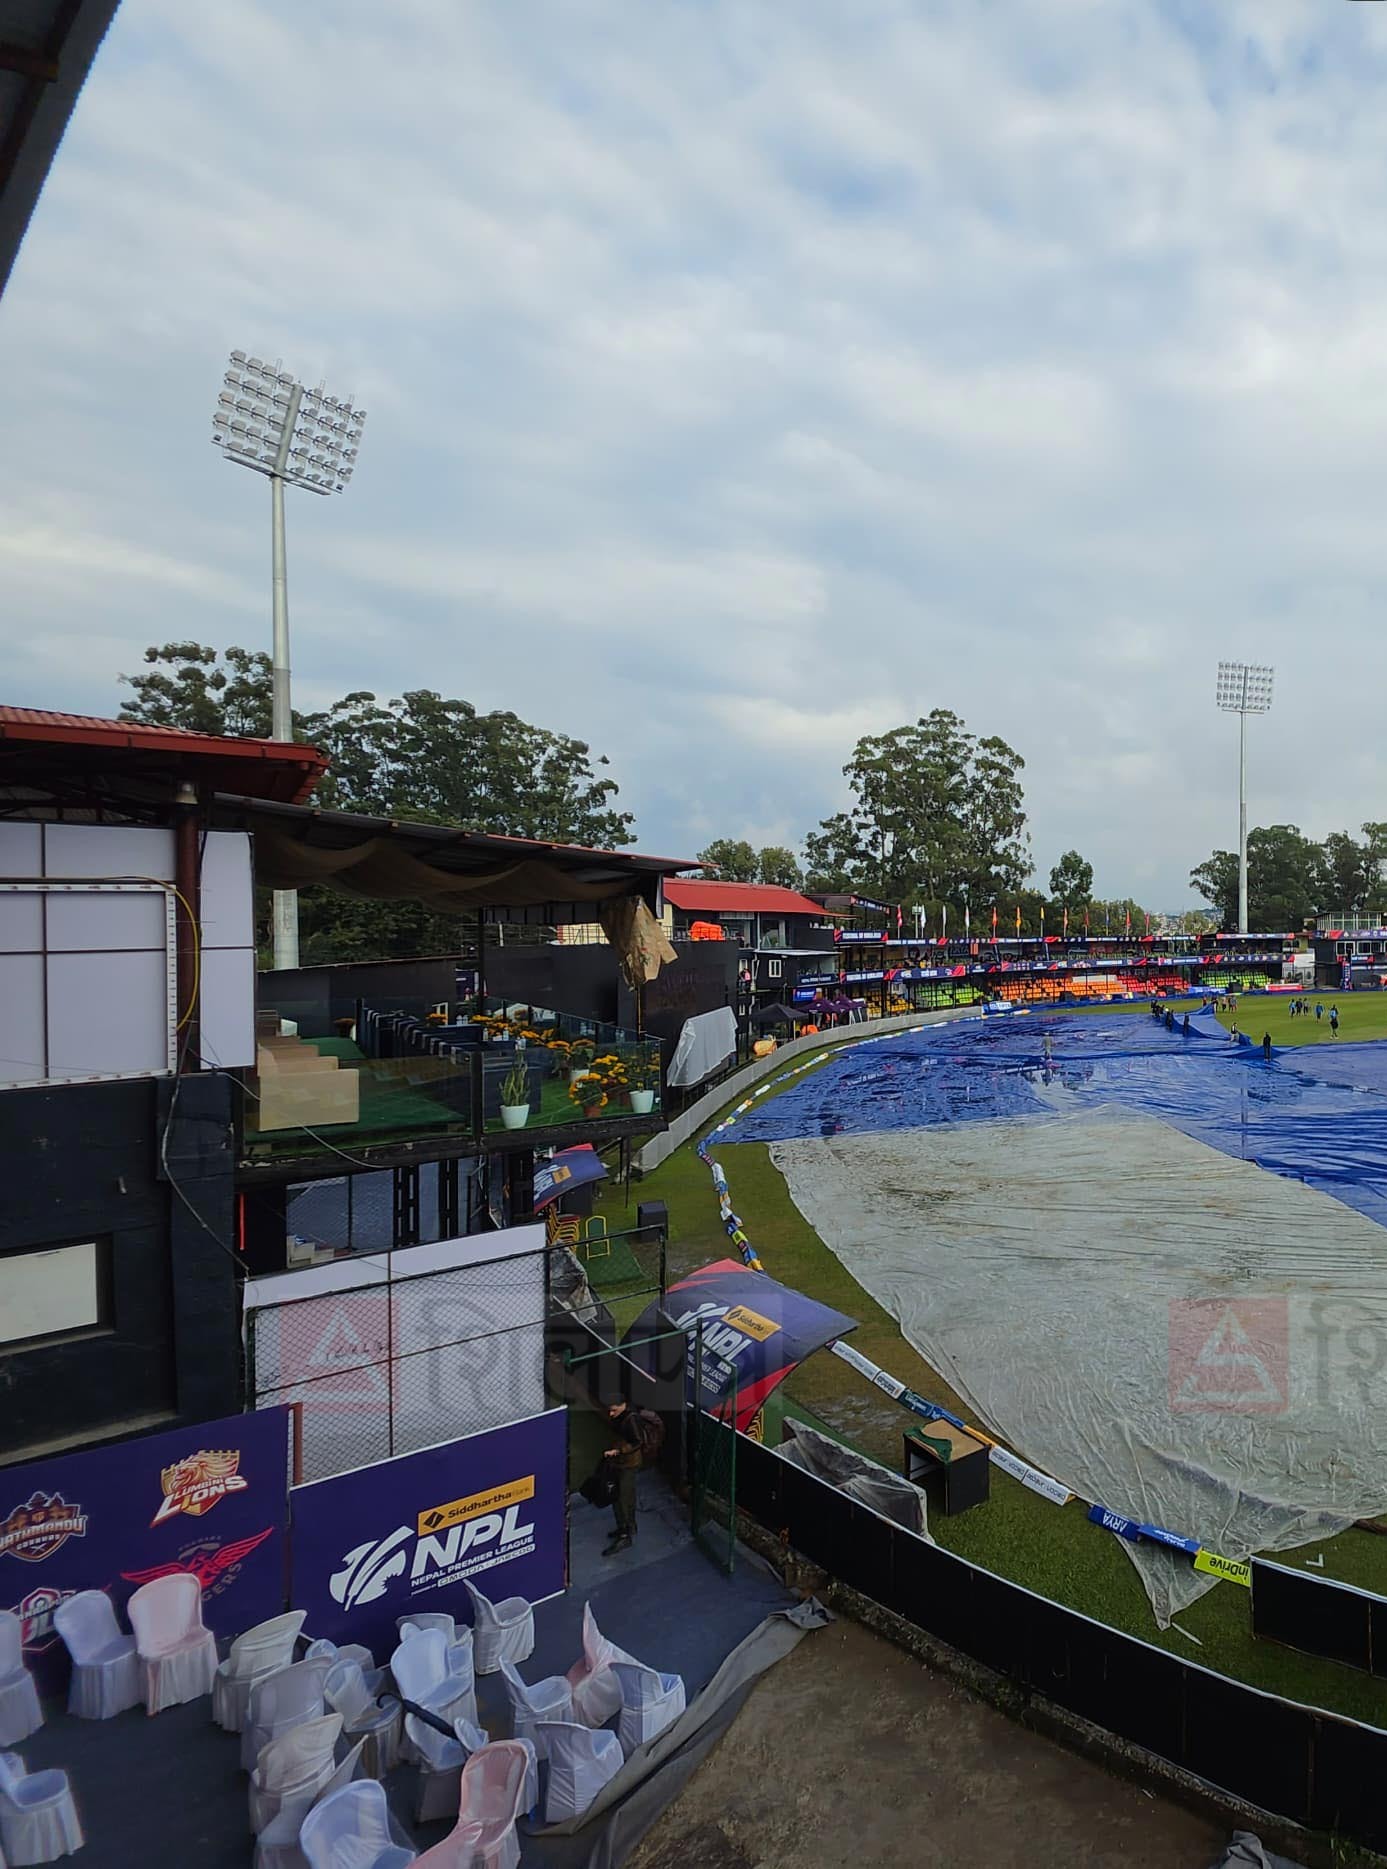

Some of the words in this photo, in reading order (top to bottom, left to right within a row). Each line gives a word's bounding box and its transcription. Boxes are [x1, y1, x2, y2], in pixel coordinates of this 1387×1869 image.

[151, 1475, 248, 1526] LIONS
[175, 1477, 225, 1500] LUMBINI
[448, 1487, 529, 1518] SiddharthaBank
[1102, 1511, 1129, 1533] ARYA
[410, 1505, 535, 1579] NPL
[411, 1568, 446, 1587] NEPAL
[447, 1549, 493, 1574] PREMIER
[495, 1535, 535, 1555] LEAGUE
[1208, 1557, 1250, 1580] inDrive
